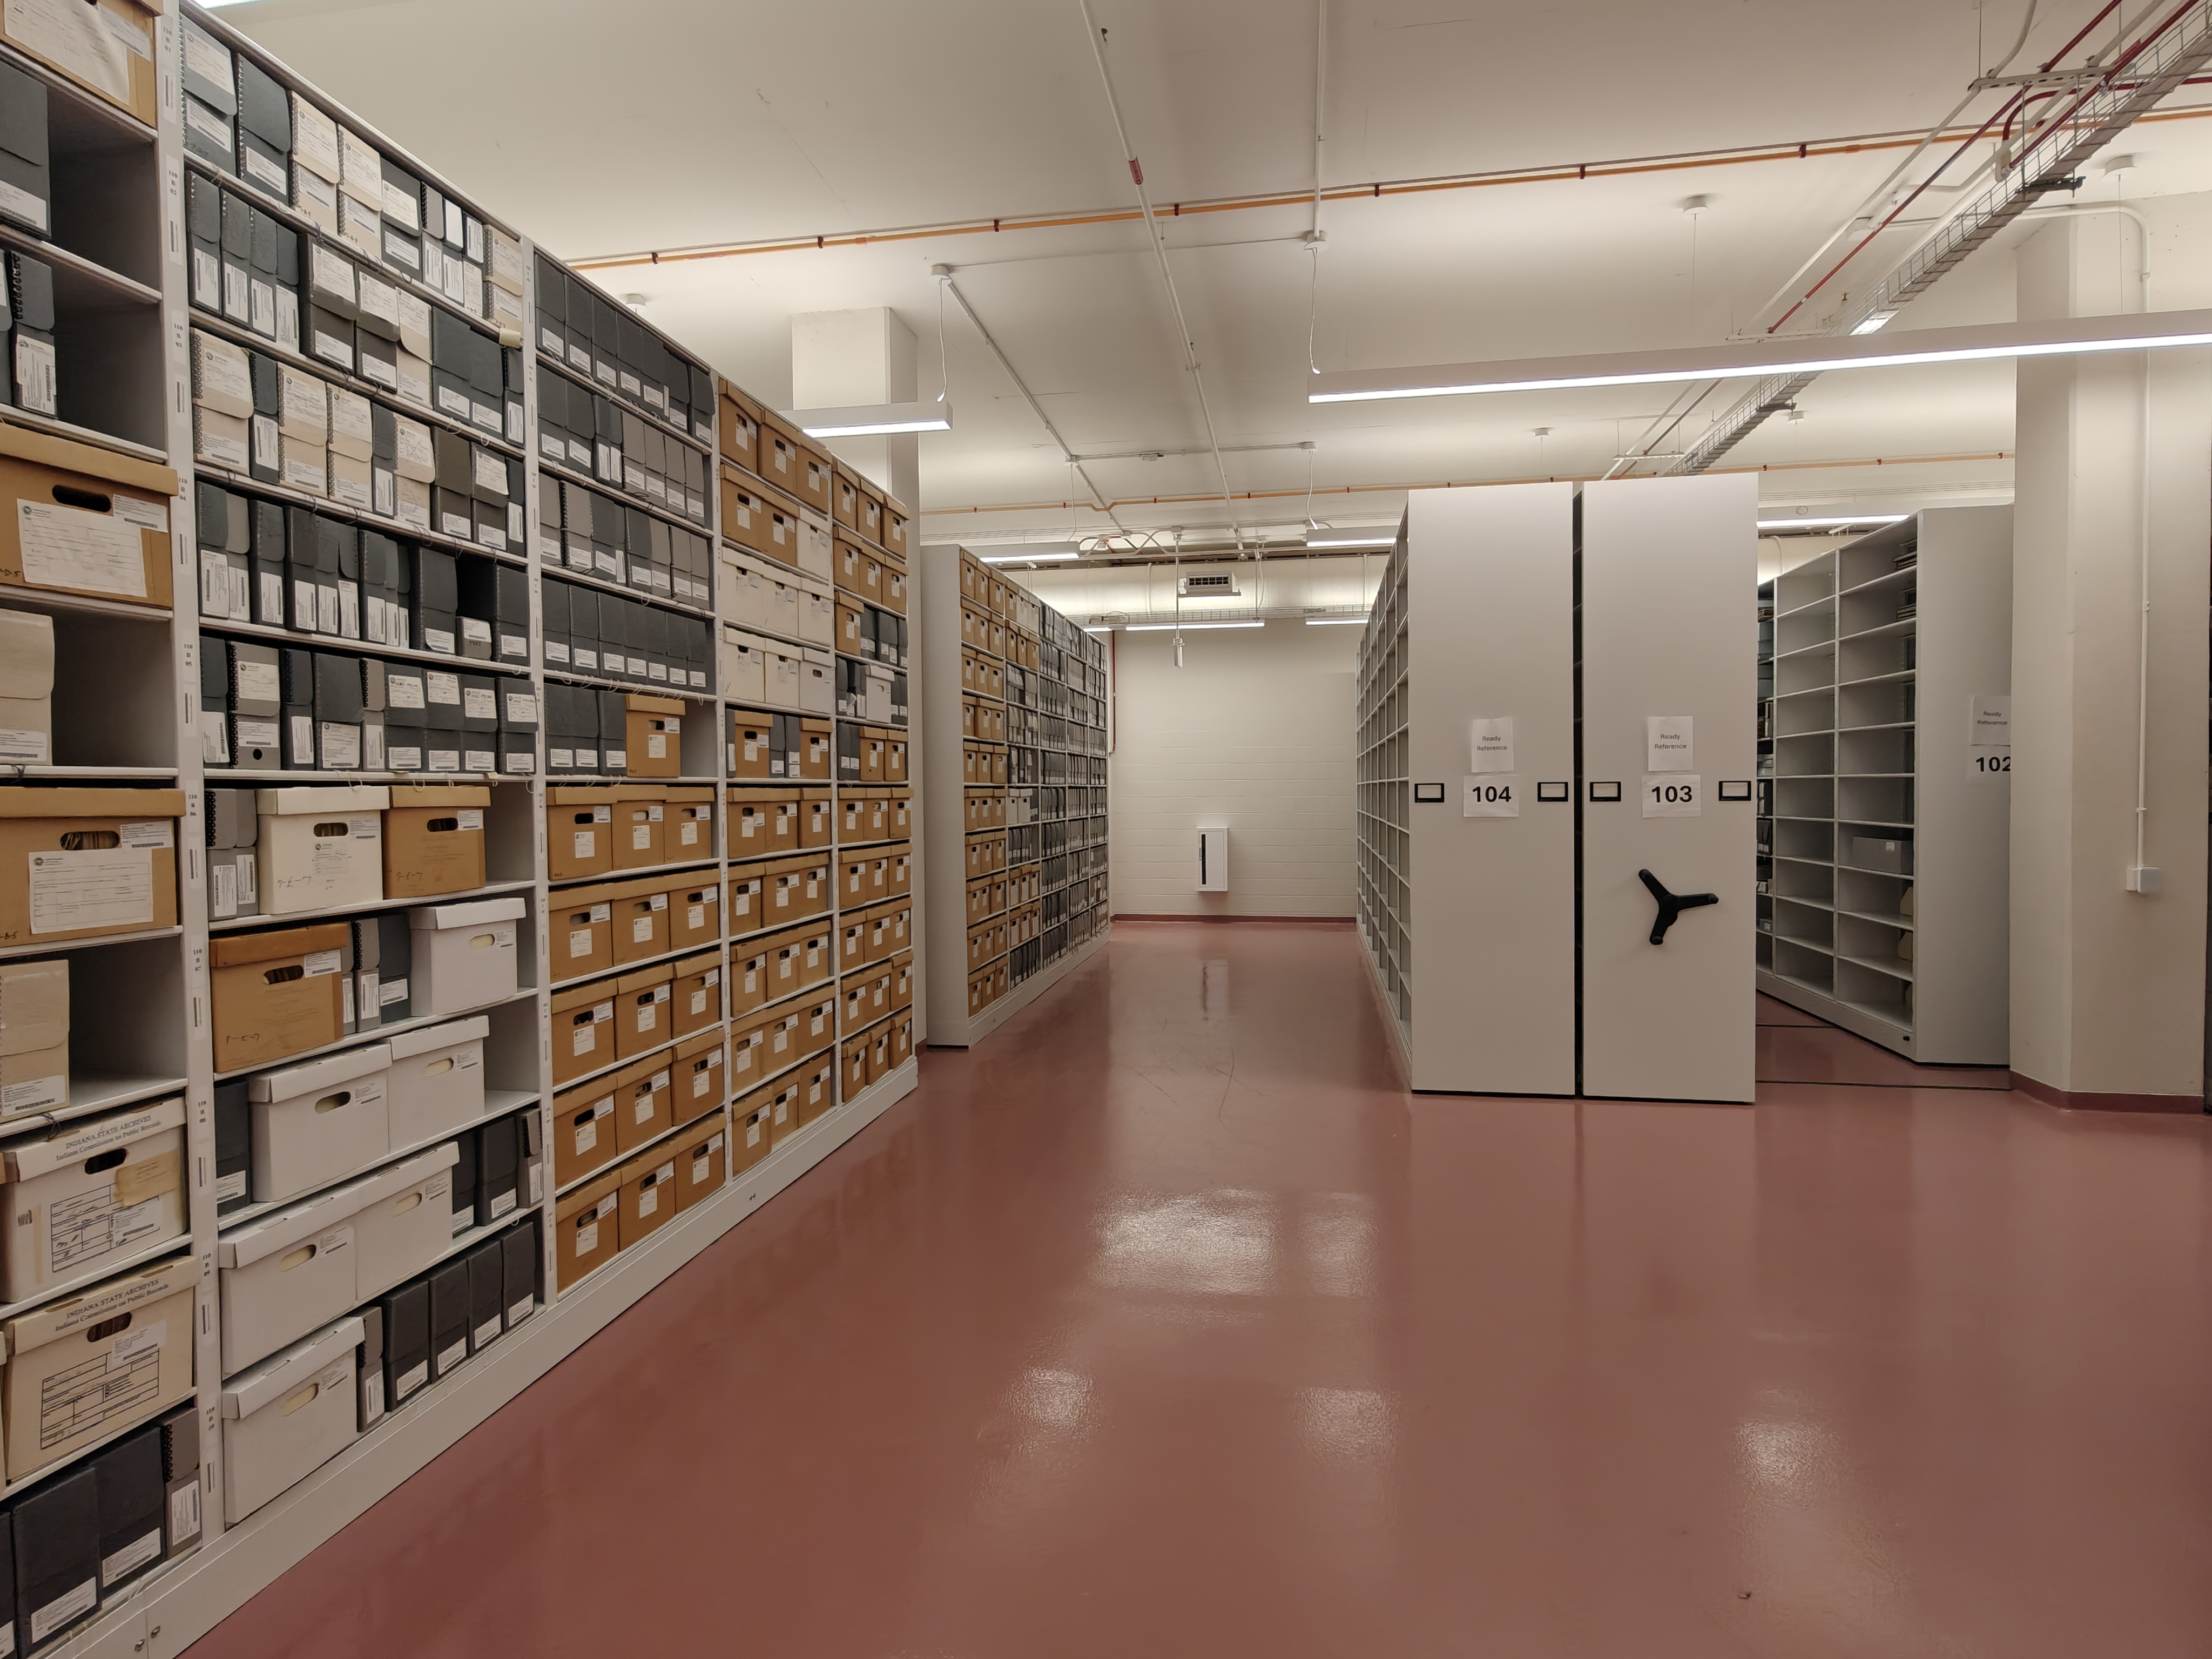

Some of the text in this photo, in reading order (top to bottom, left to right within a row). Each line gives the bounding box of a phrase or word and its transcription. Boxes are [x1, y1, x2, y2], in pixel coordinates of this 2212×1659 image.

[1975, 756, 2011, 772] 102
[1472, 786, 1512, 802] 104
[1651, 786, 1692, 802] 103
[65, 1115, 151, 1149] INDIANA STATE ARCHIVES
[66, 1279, 159, 1319] INDIANA STATE ARCHIVES
